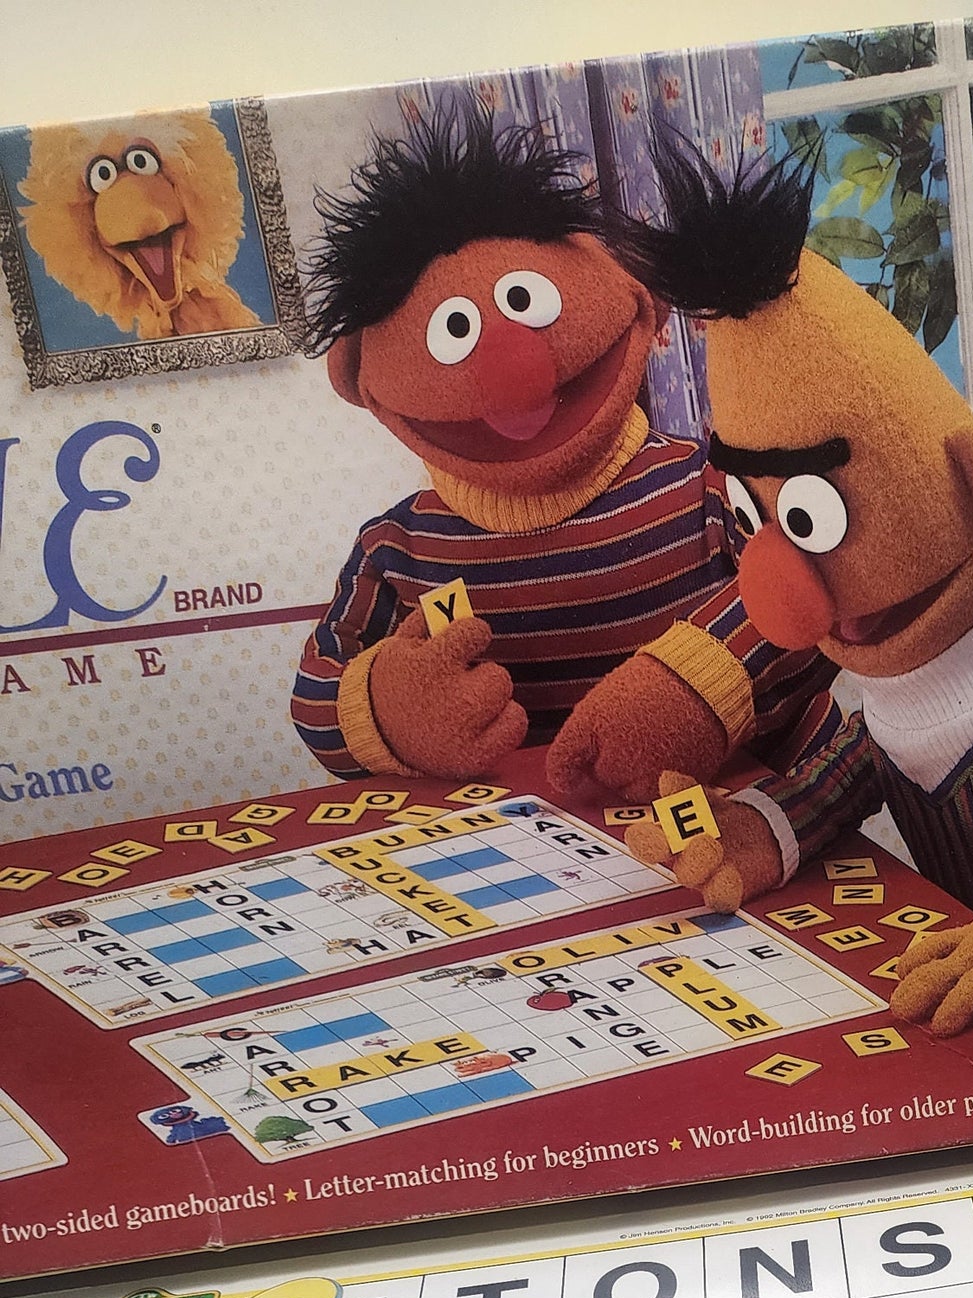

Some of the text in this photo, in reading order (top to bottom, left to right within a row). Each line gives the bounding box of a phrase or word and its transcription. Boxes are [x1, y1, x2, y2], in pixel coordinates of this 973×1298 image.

[174, 582, 263, 613] BRAND
[433, 592, 456, 624] Y
[0, 762, 114, 803] Game
[322, 806, 351, 819] D
[671, 800, 704, 839] E
[656, 962, 769, 1033] PLUM
[861, 1034, 893, 1048] S
[280, 1036, 471, 1094] RAKE
[765, 1060, 803, 1078] E
[689, 1104, 856, 1150] Word-building
[861, 1101, 894, 1127] for
[899, 1097, 957, 1121] older
[304, 1137, 660, 1201] Letter-matching for beginners
[1, 1183, 277, 1245] two-sided gameboards!
[799, 1205, 828, 1215] Bradley
[877, 1194, 901, 1204] Rights
[628, 1231, 642, 1240] Jim
